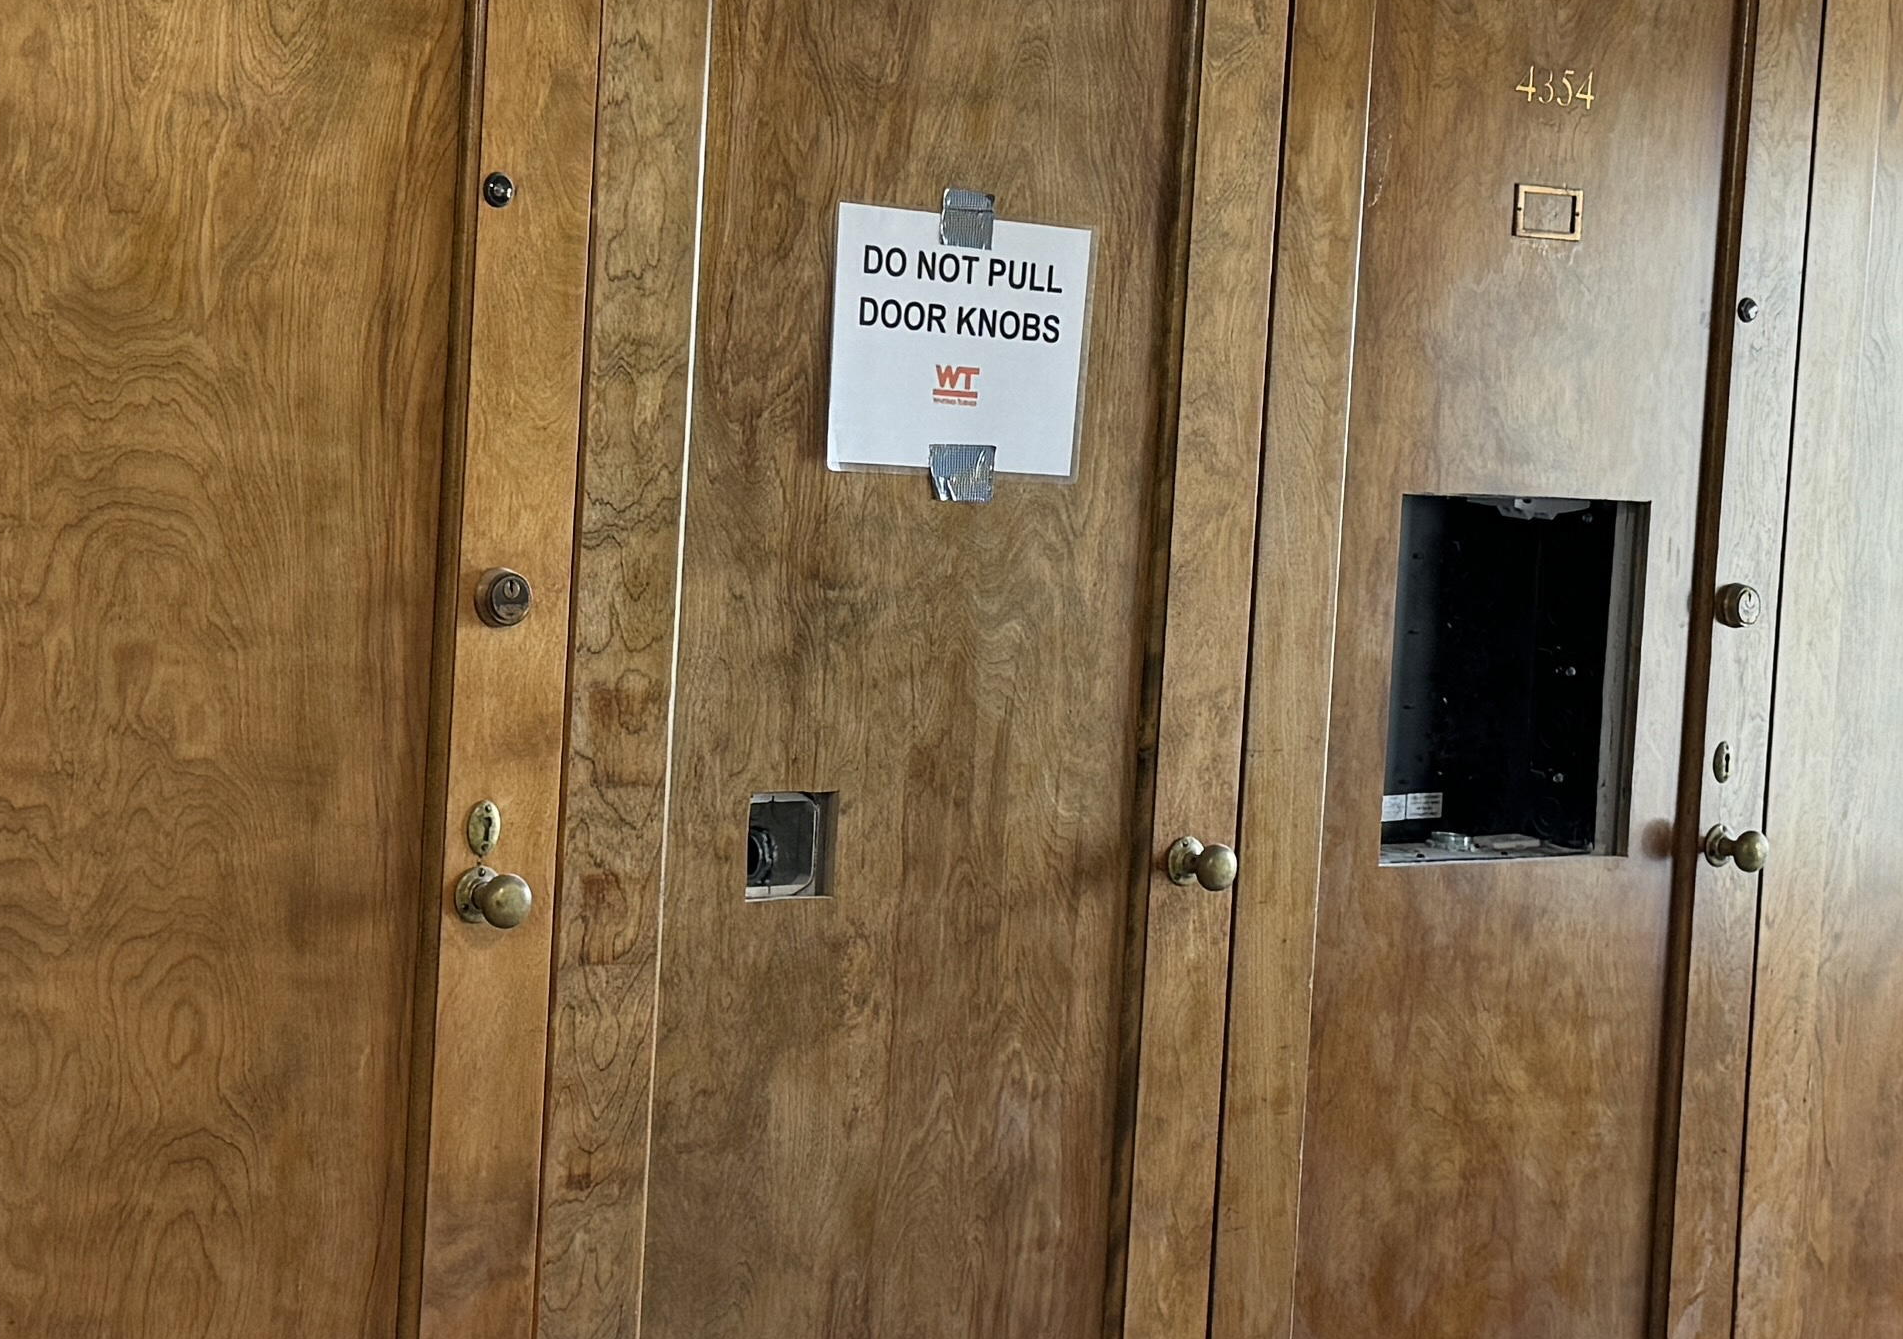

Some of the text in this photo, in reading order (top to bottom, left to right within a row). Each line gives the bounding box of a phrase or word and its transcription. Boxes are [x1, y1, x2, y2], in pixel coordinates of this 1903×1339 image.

[1515, 65, 1595, 110] 4354
[862, 245, 1063, 293] DO NOT PULL
[858, 296, 1061, 343] DOOR KNOBS
[935, 364, 980, 390] WT
